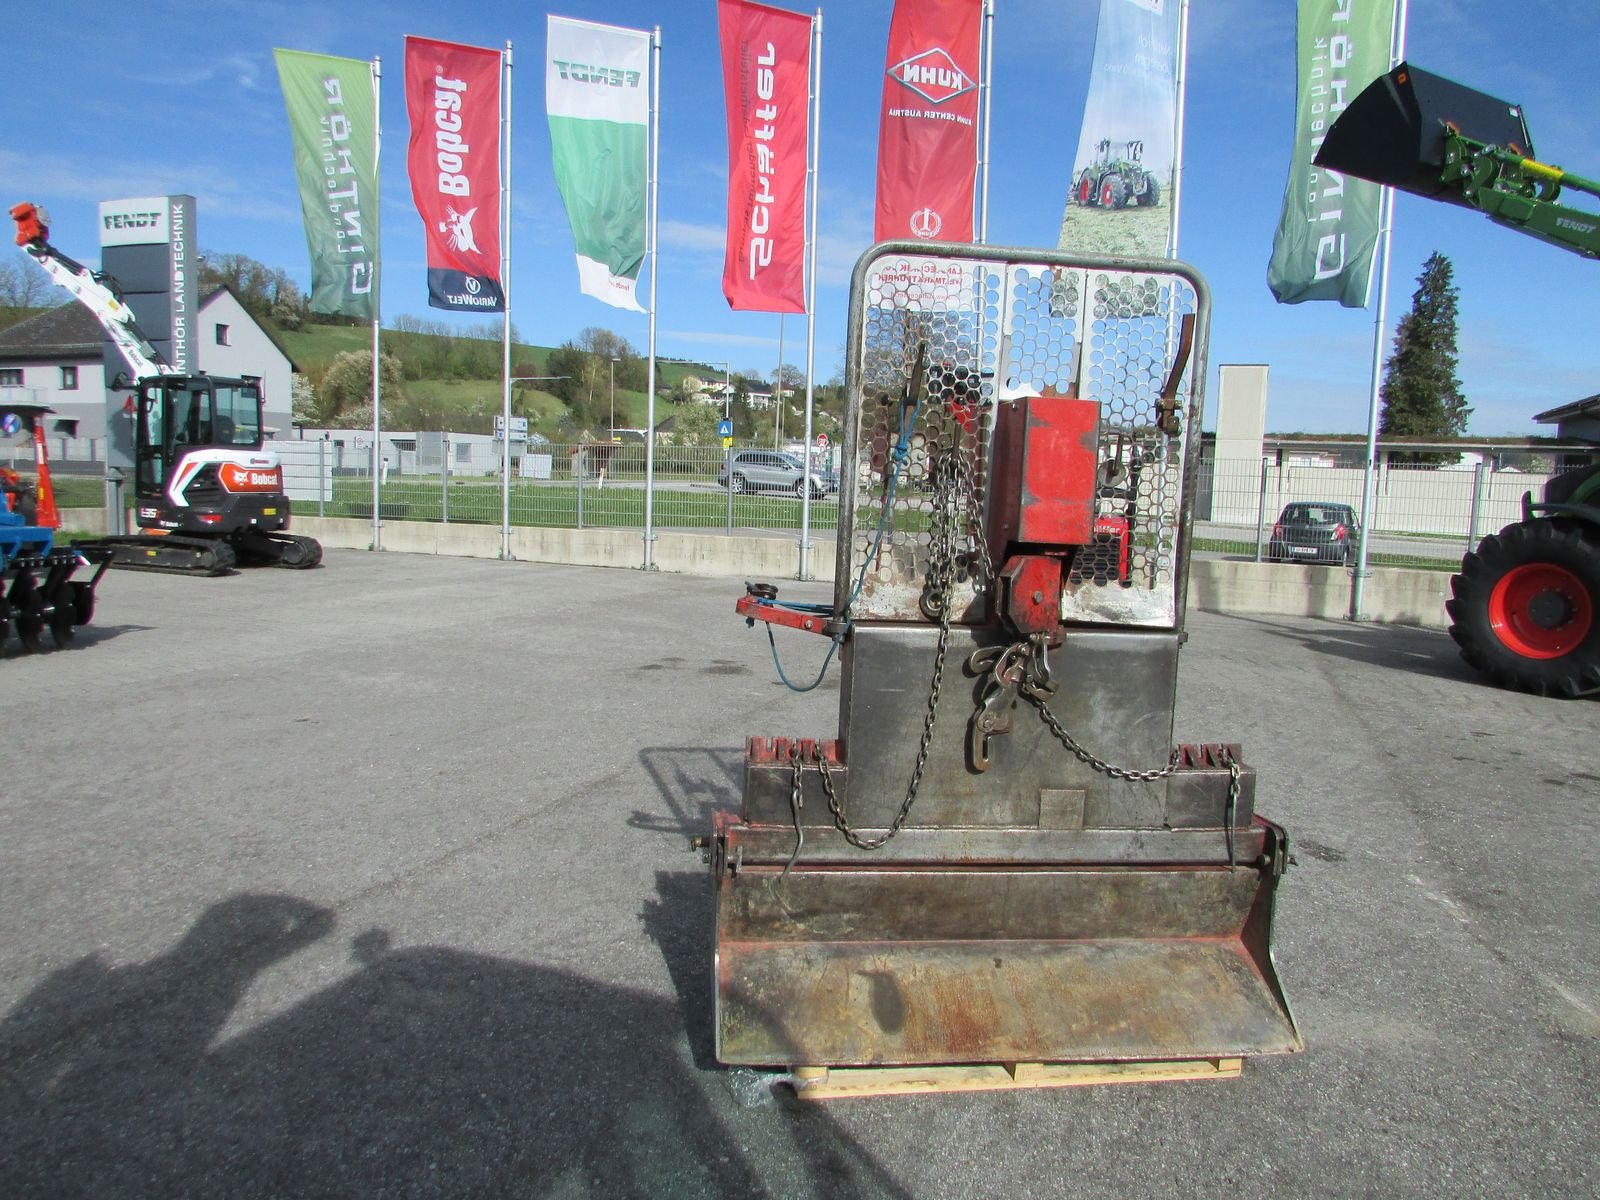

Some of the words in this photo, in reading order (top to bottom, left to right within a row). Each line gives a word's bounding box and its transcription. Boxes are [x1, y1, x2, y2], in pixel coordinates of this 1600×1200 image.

[104, 212, 162, 230] FENDT
[1556, 217, 1597, 234] FENDT
[172, 203, 185, 313] LANDTECHNIK
[172, 317, 186, 375] INTHÖR
[251, 472, 278, 485] Bobcat
